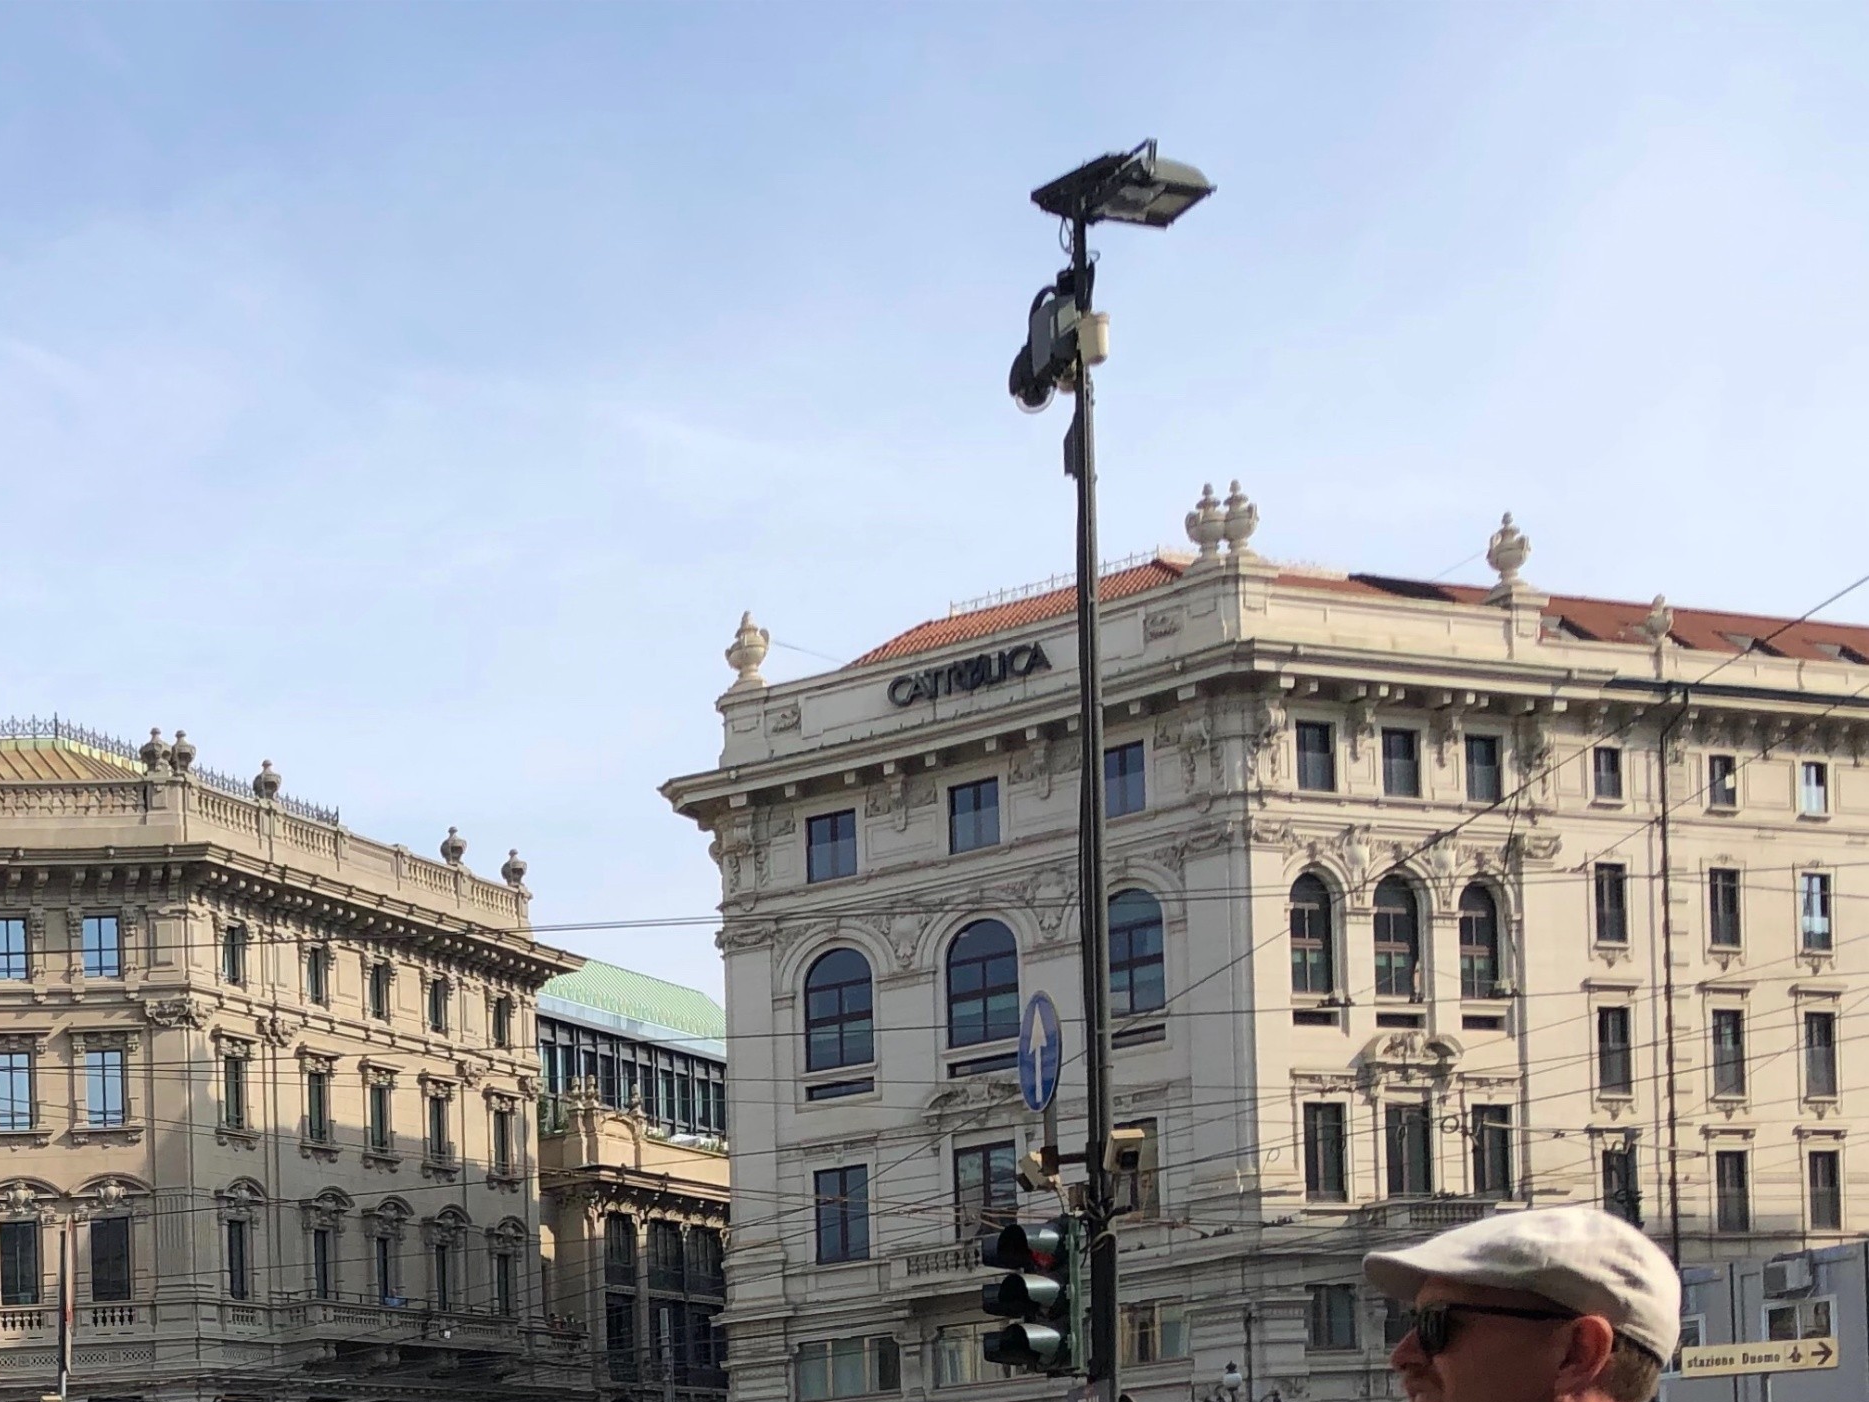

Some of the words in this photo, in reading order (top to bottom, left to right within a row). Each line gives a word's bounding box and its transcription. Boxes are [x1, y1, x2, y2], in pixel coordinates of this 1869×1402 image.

[887, 641, 1052, 707] CATTOLICA
[1687, 1355, 1735, 1369] stazione
[1742, 1352, 1780, 1365] Duomo
